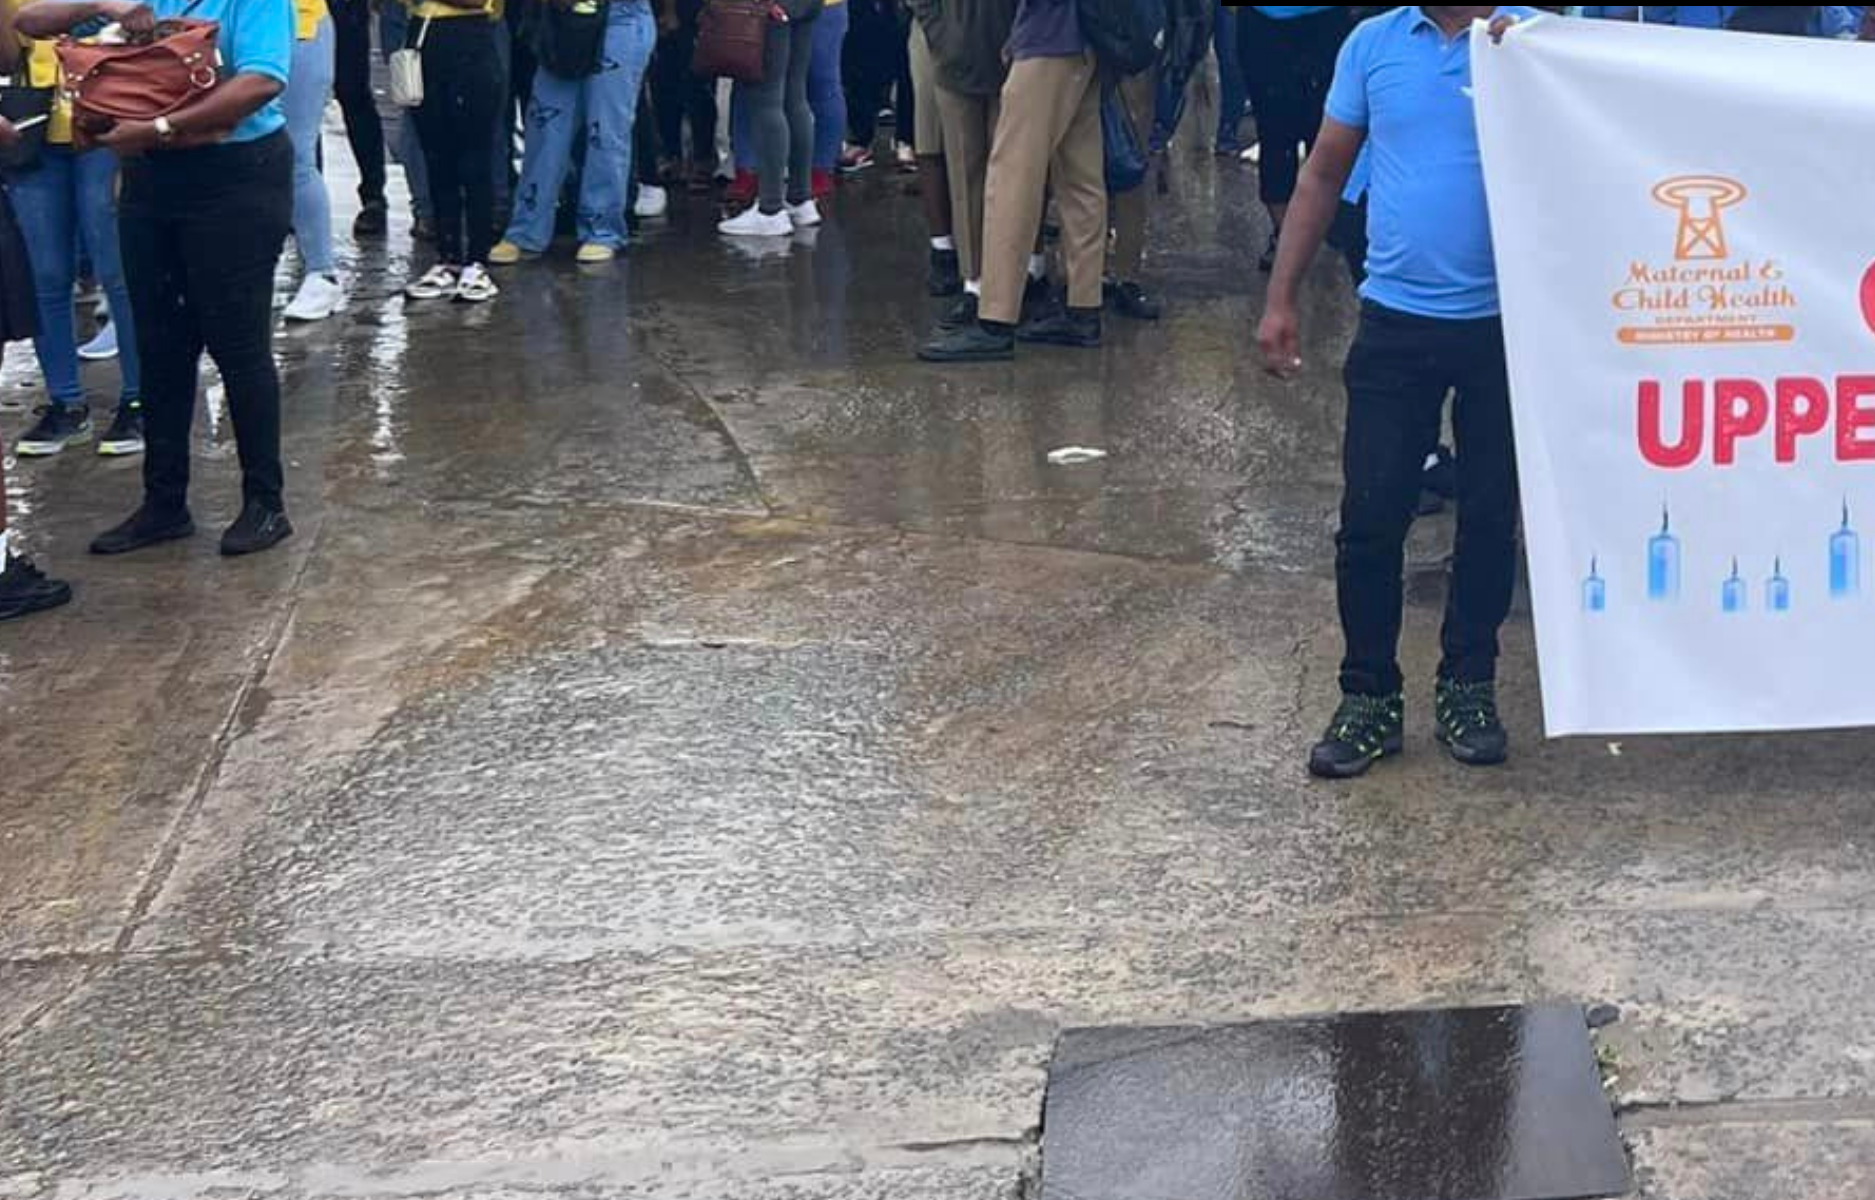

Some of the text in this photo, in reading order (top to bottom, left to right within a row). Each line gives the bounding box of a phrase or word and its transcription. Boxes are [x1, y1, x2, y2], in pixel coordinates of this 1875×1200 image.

[1626, 260, 1749, 285] Maternal
[1612, 284, 1797, 310] Child Health
[1655, 315, 1758, 325] DEPARTMENT
